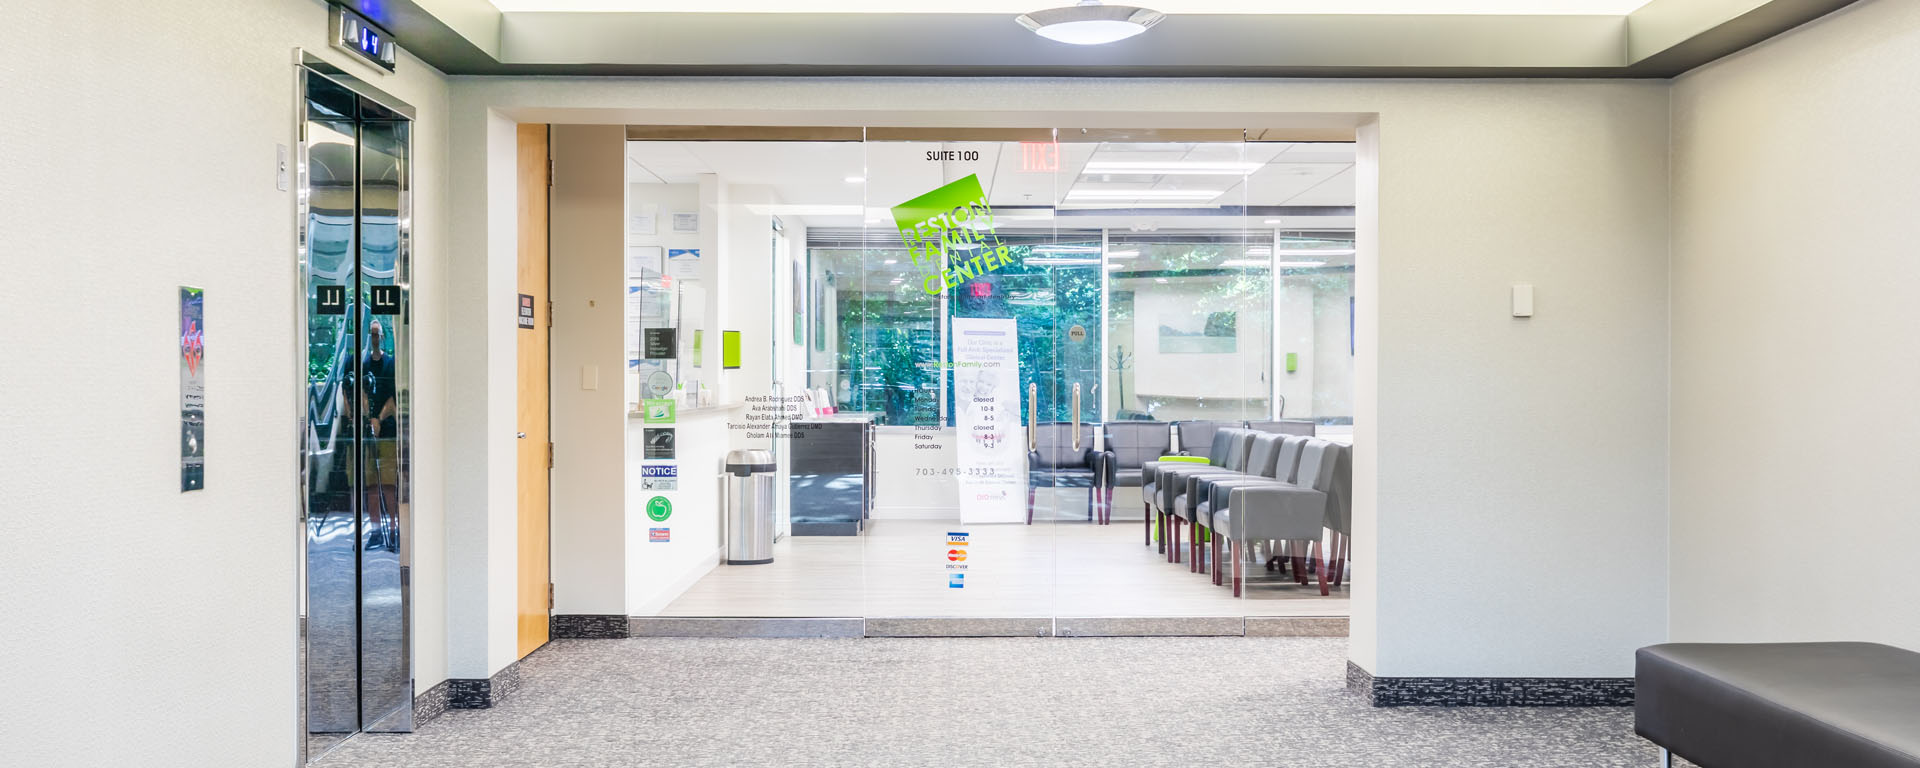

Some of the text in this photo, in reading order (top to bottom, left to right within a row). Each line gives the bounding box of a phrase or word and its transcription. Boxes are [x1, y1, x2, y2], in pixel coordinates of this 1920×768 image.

[371, 34, 378, 54] 4
[926, 150, 979, 161] SUITE 100
[901, 196, 991, 248] RESTON
[908, 215, 996, 267] FAMILY
[923, 245, 1013, 295] CENTER
[376, 289, 395, 306] LL
[914, 361, 1001, 369] www.RestonFamily.com
[768, 395, 793, 404] Rodriguez
[793, 395, 805, 403] DDS
[914, 397, 940, 405] Monday
[914, 406, 940, 414] Tuesday
[746, 414, 761, 422] Rayan
[791, 413, 803, 421] DMD
[914, 416, 950, 424] Wednesday
[746, 422, 771, 430] Alexander
[810, 422, 823, 430] DMD
[746, 431, 765, 439] Gholam
[793, 431, 805, 439] DDS
[642, 467, 677, 475] NOTICE
[915, 468, 996, 476] 703-495-3333
